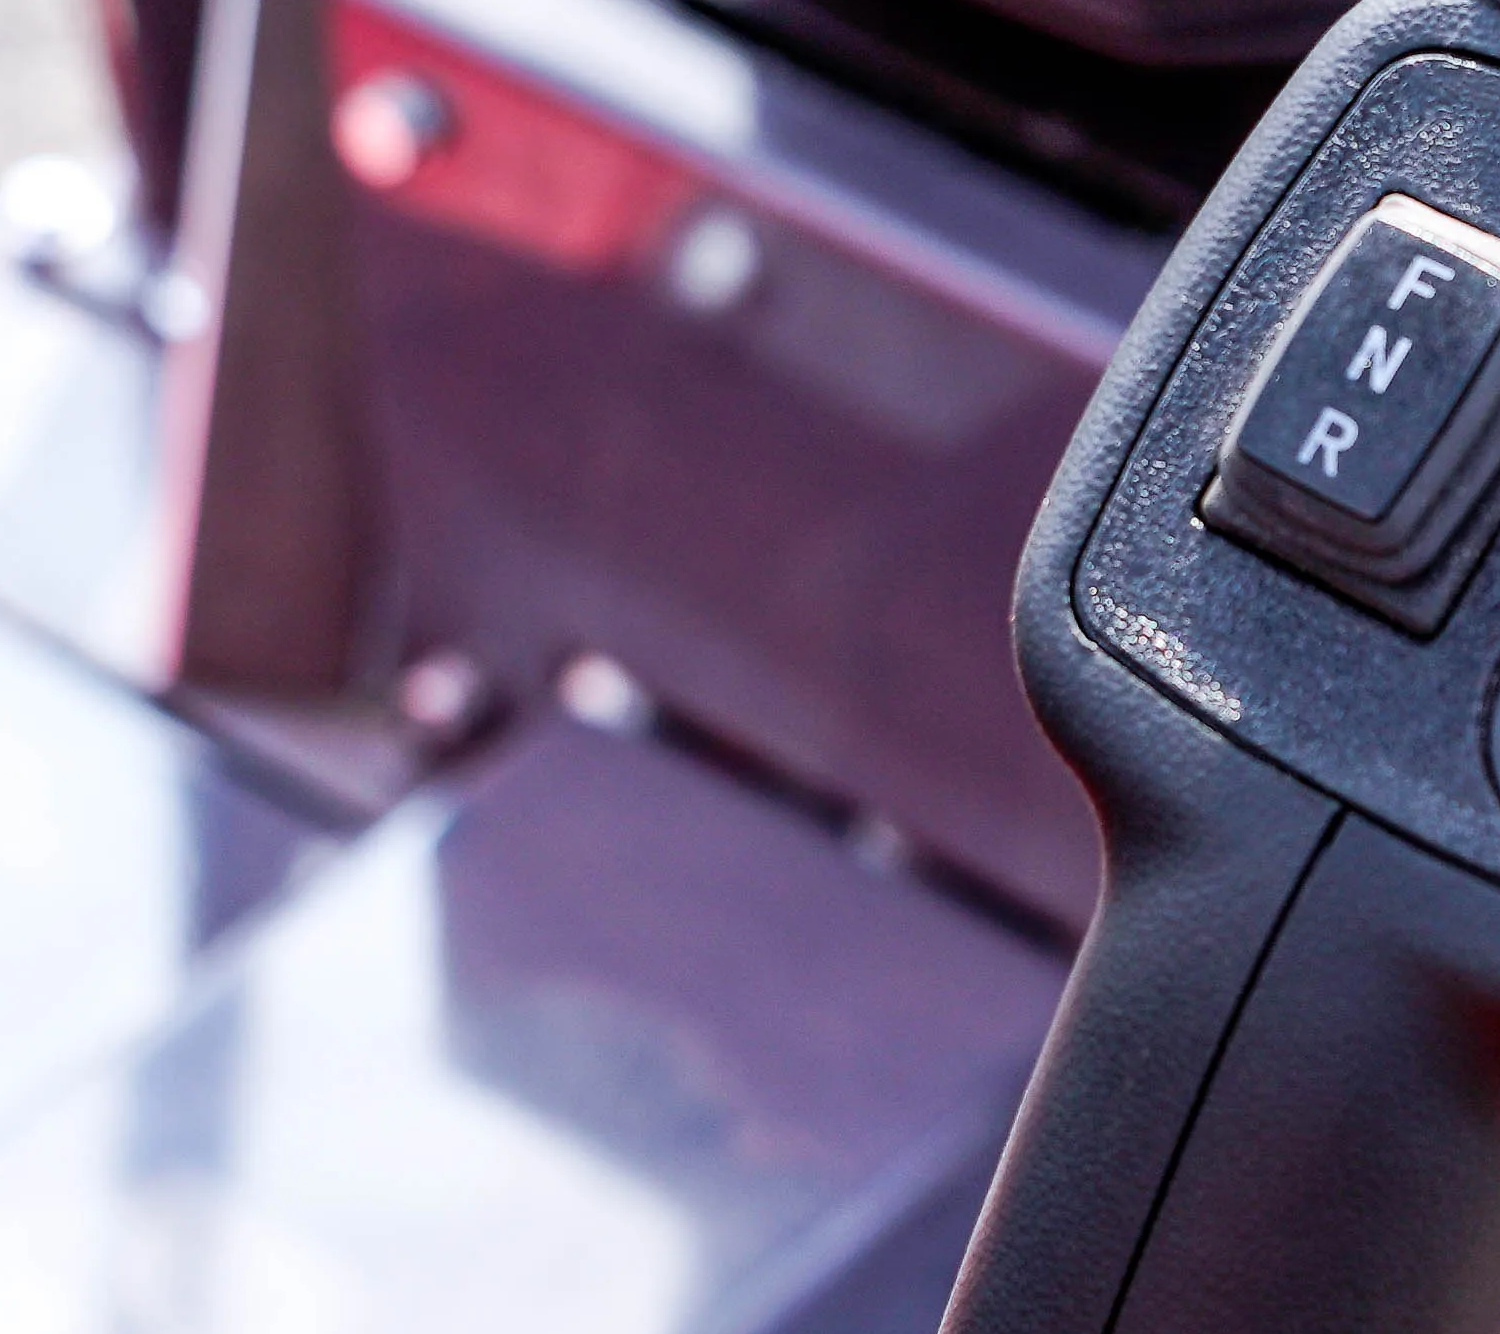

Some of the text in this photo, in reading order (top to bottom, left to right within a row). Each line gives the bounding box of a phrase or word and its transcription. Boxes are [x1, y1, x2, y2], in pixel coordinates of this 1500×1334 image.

[1387, 255, 1456, 310] F
[1345, 324, 1413, 394] N
[1296, 406, 1359, 477] R
